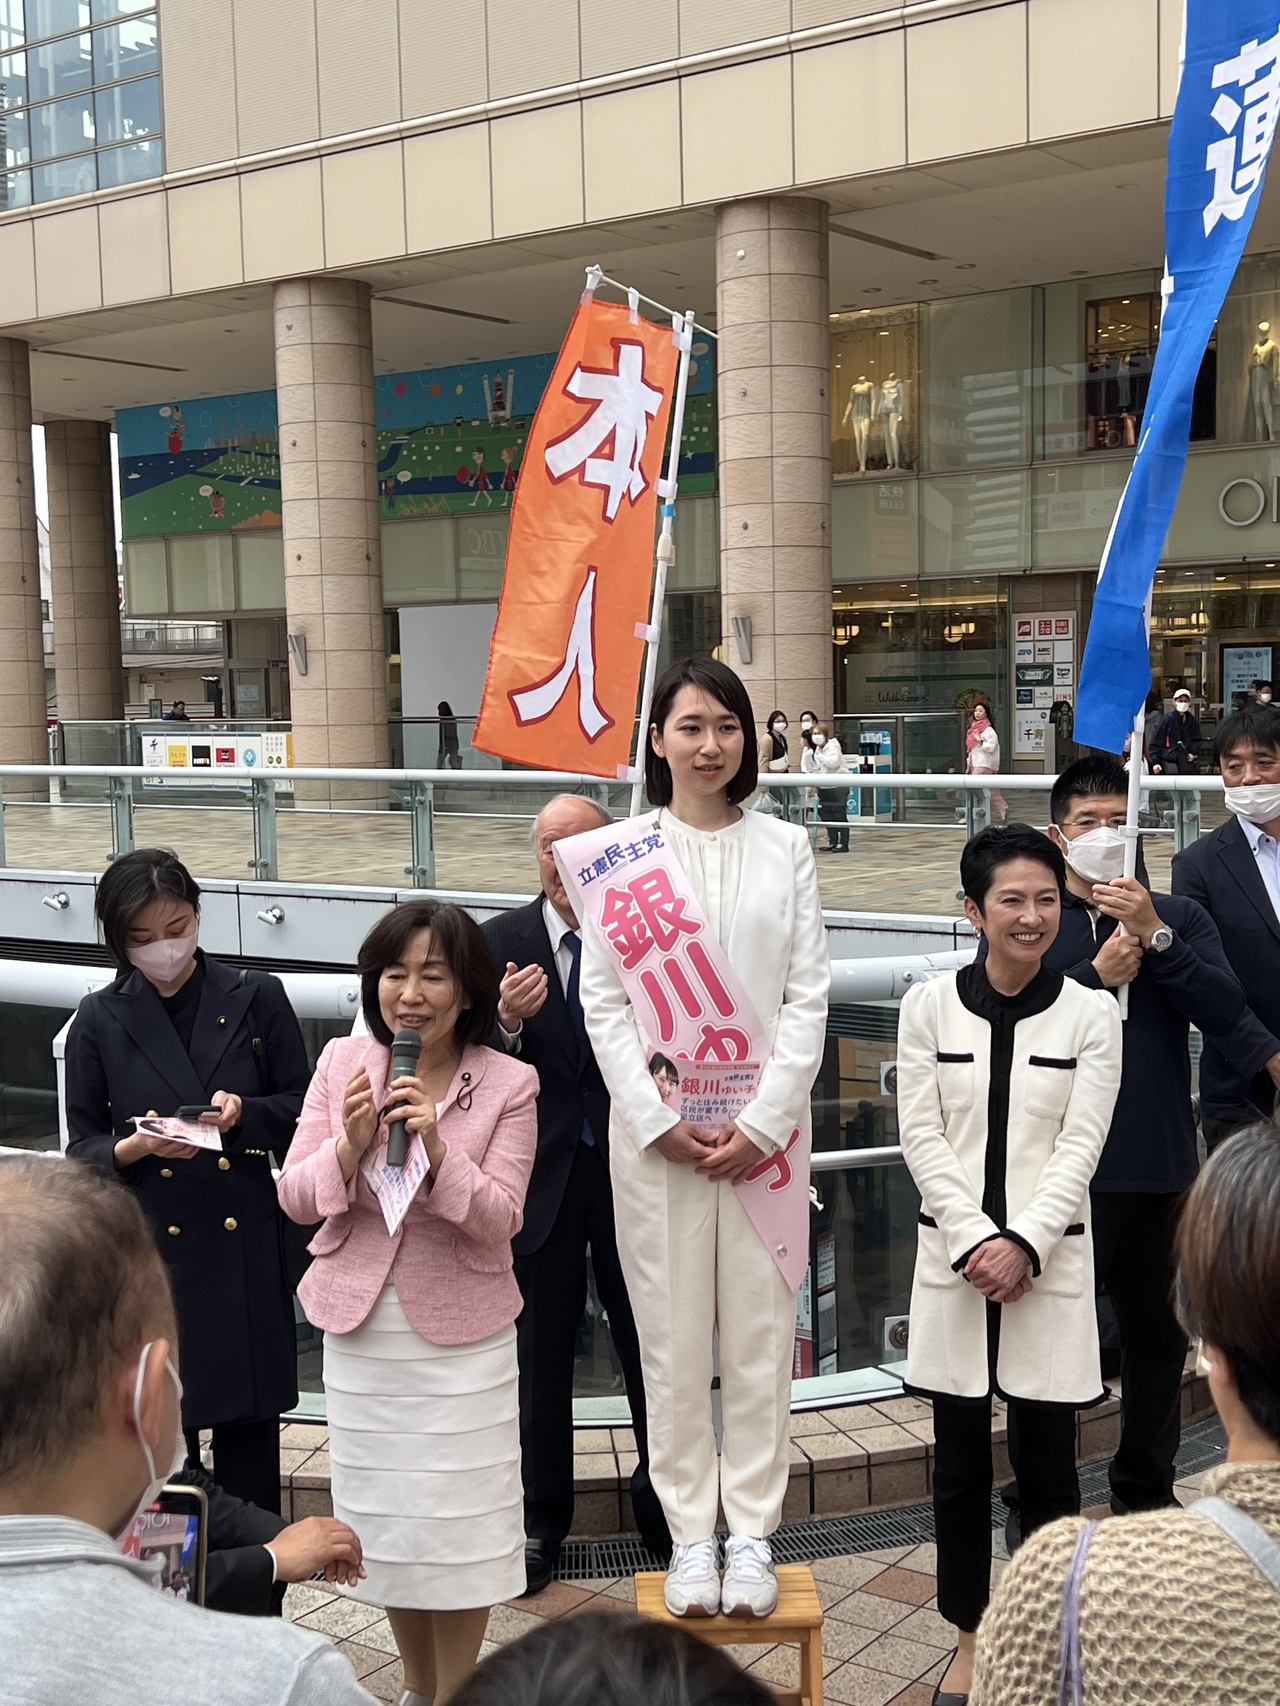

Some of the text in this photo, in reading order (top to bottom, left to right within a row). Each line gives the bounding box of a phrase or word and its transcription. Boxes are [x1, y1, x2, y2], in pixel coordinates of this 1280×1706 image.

[507, 338, 663, 743] 本人
[578, 833, 665, 887] 立憲民主党
[681, 1077, 755, 1095] 銀川ゆい子
[681, 1105, 728, 1114] 区民が愛する
